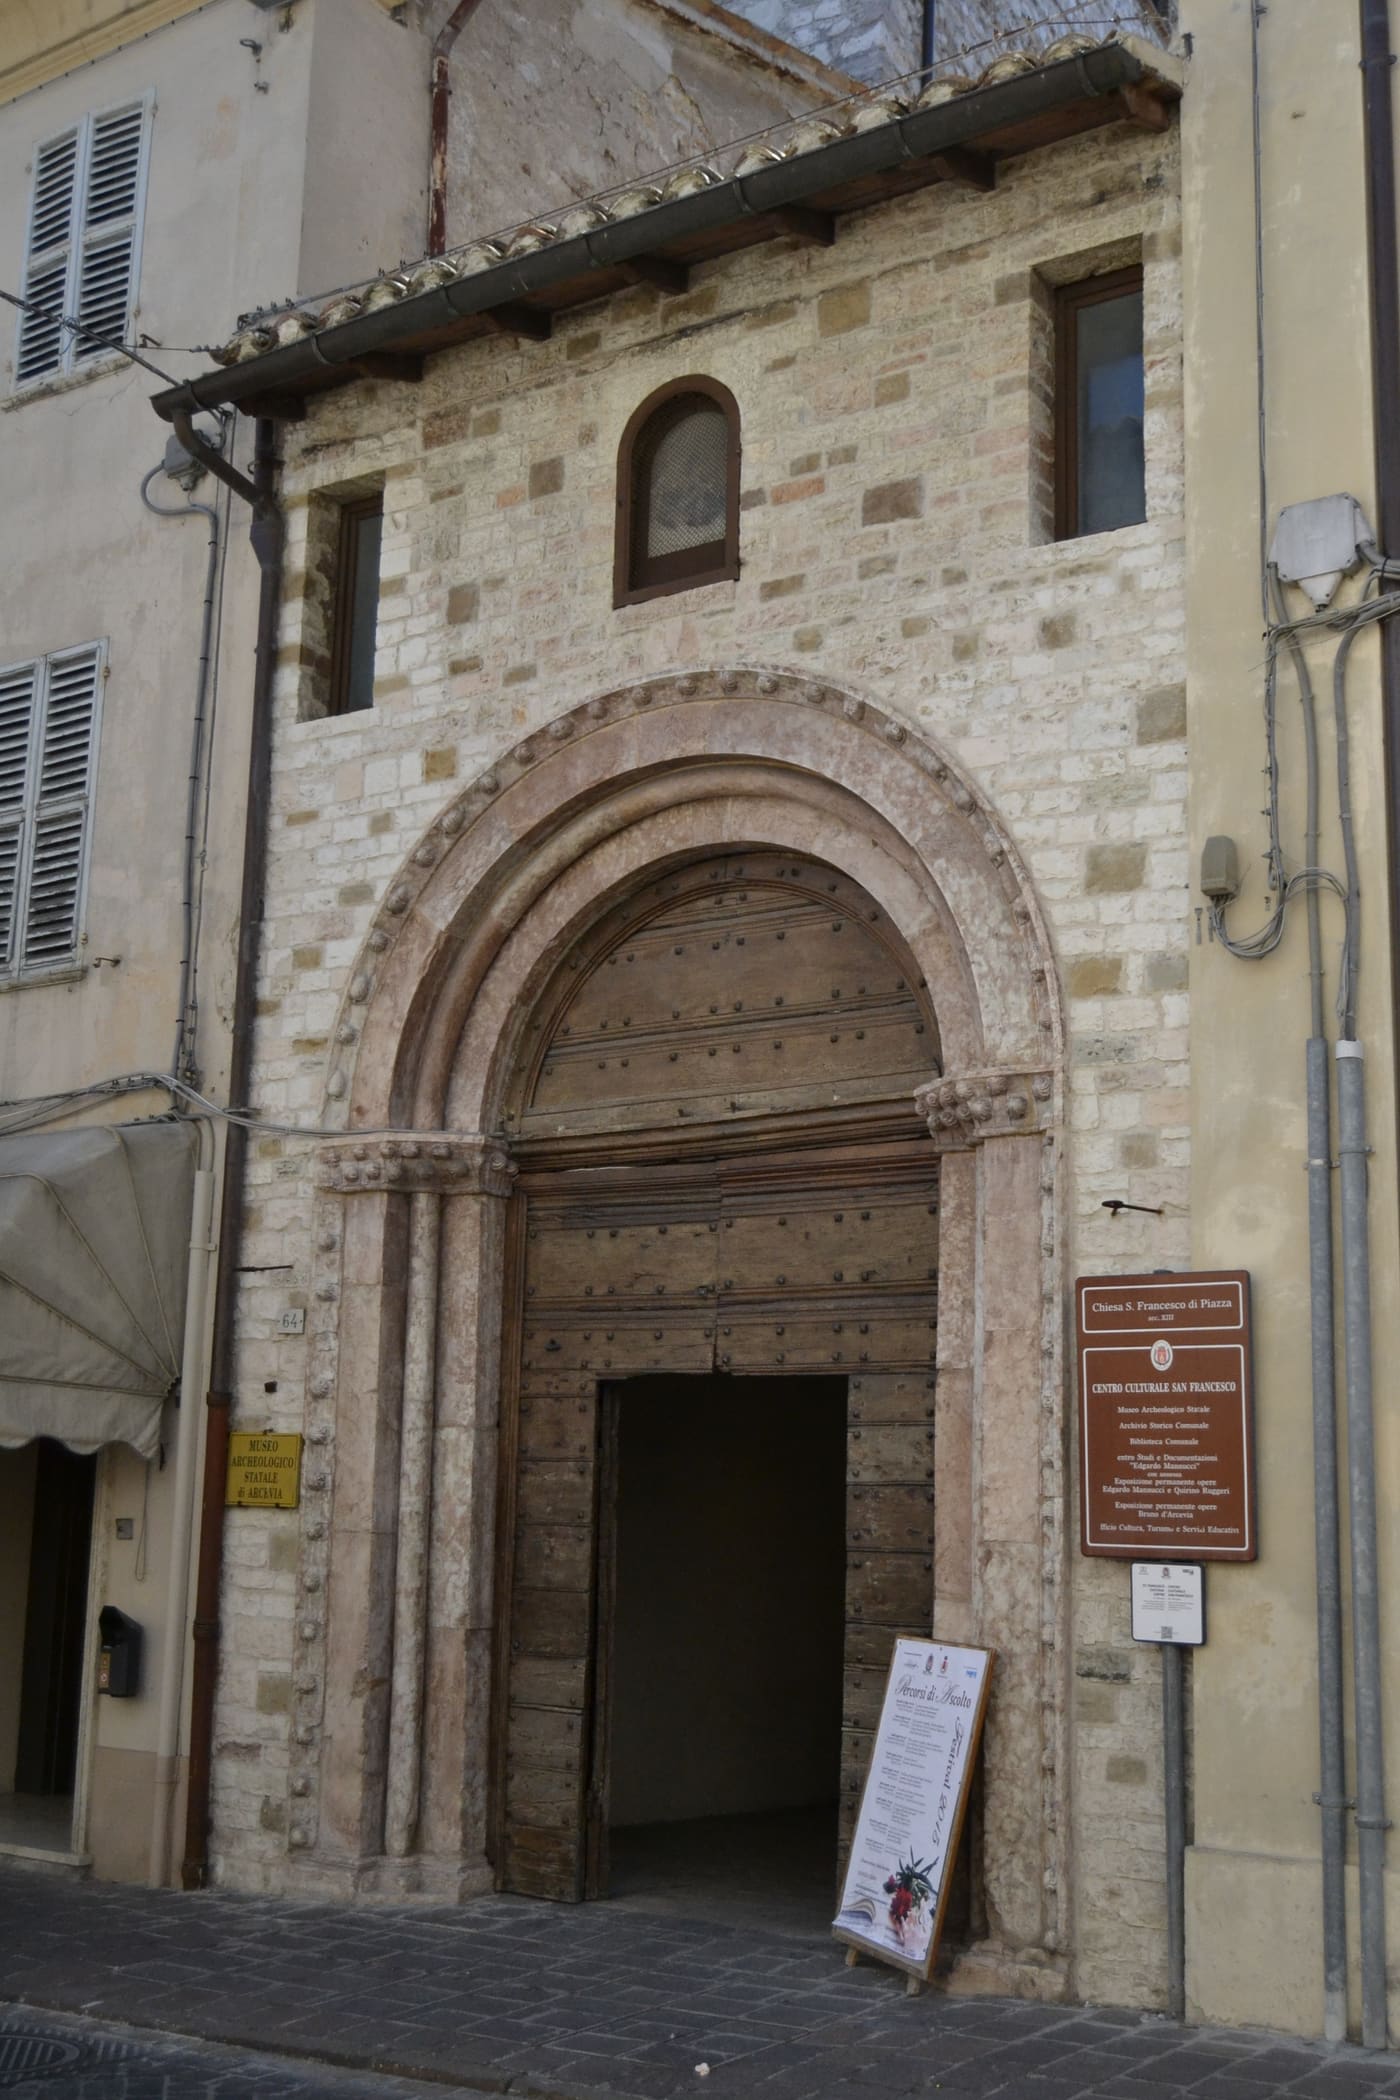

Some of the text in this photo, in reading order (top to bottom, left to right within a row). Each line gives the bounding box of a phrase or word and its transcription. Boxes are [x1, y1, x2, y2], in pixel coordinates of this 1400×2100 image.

[1092, 1299, 1232, 1312] Chiesa S. Francesco di Piazza
[1092, 1382, 1236, 1393] CENTRO CULTURALE SAN FRANCESCO
[1117, 1406, 1139, 1414] Museo
[1141, 1406, 1184, 1414] Archeologico
[249, 1439, 279, 1452] MUSEO
[231, 1455, 294, 1468] ARCHEOLOGICO
[244, 1471, 278, 1484] STATALE
[1114, 1478, 1153, 1486] Esposizione
[1102, 1485, 1130, 1494] Edgardo
[1173, 1487, 1200, 1495] Quirino
[1202, 1487, 1230, 1495] Ruggeri
[1114, 1502, 1153, 1510] Esposizione
[1161, 1511, 1193, 1519] d'Arcevia
[895, 1674, 926, 1700] Percorsi
[926, 1684, 937, 1702] di
[936, 1681, 972, 1709] Ascolto
[943, 1716, 964, 1789] Festival
